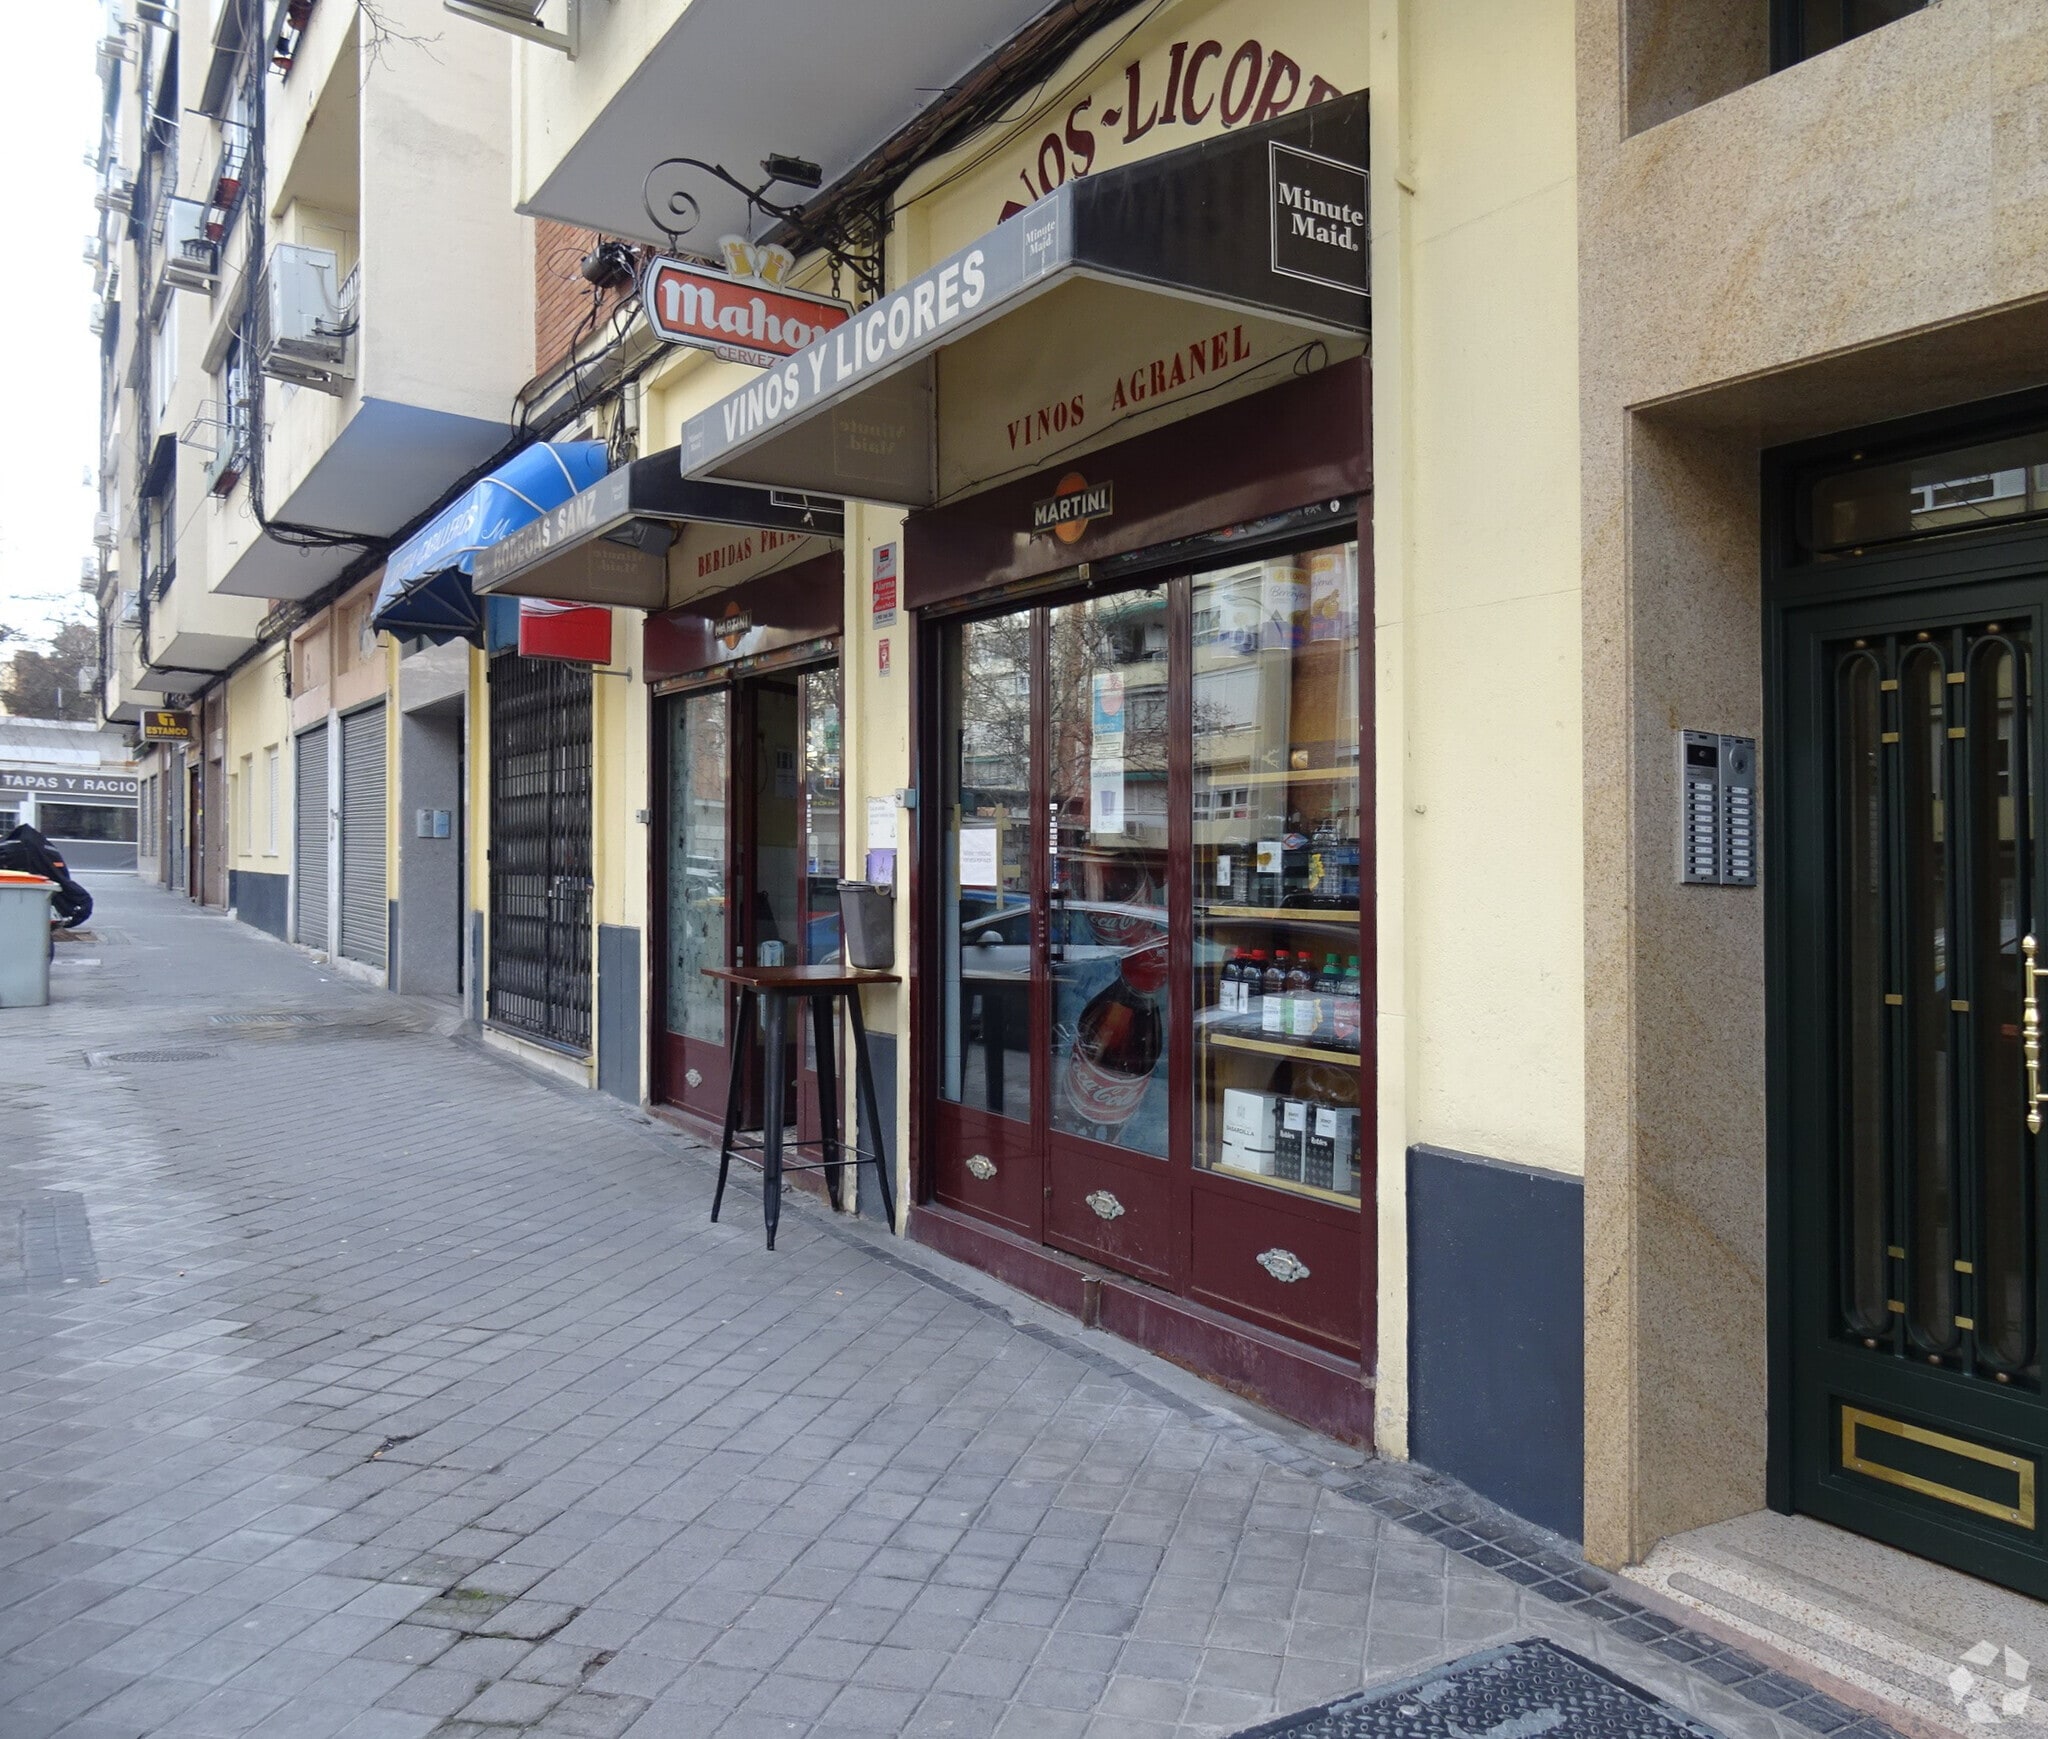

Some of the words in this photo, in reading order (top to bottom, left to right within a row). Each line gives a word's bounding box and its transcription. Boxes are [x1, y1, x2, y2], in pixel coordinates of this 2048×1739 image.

[1278, 182, 1364, 227] Minute
[1025, 220, 1056, 245] Minute
[718, 346, 784, 368] CERVEZ
[723, 363, 800, 443] VINOS
[808, 343, 827, 395] Y
[836, 250, 985, 382] LICORES
[1007, 394, 1084, 451] VINOS
[1111, 325, 1250, 411] AGRANEL
[1034, 487, 1106, 527] MARTINI
[494, 518, 550, 571] BODEGAS
[558, 490, 596, 541] SANZ
[698, 537, 751, 577] BEBIDAS
[760, 530, 804, 553] FRIA
[715, 616, 749, 636] MARTINI
[146, 726, 188, 736] ESTANCO
[3, 775, 58, 788] TAPAS
[66, 779, 77, 788] Y
[84, 779, 137, 792] RACIO
